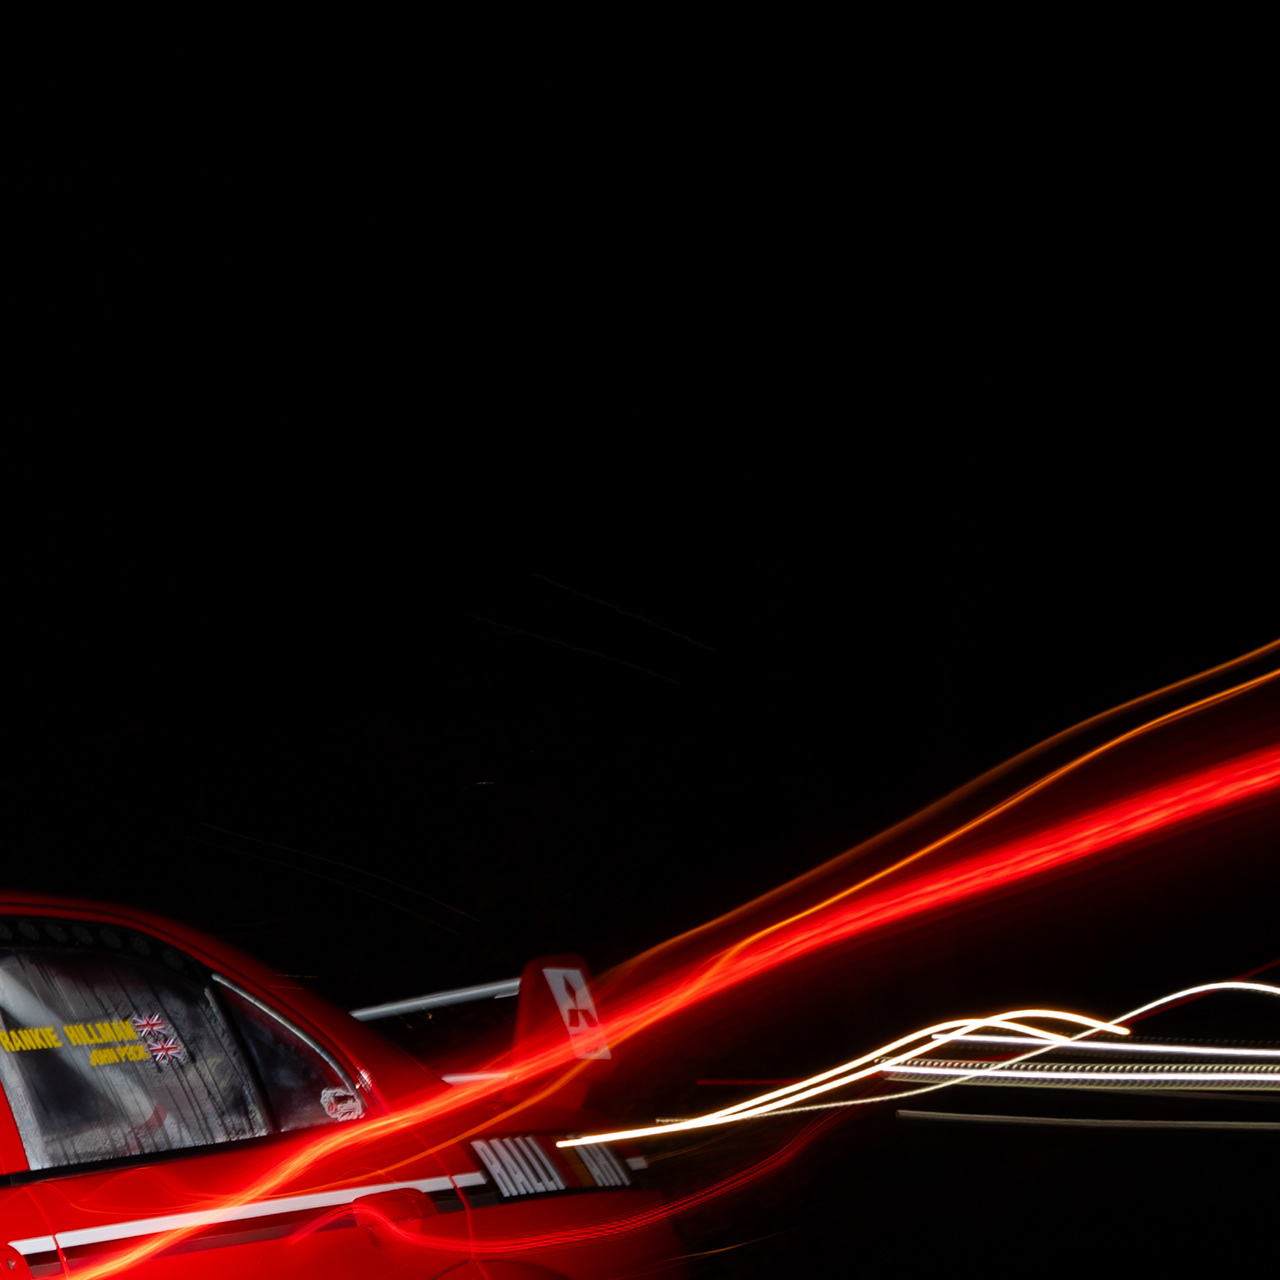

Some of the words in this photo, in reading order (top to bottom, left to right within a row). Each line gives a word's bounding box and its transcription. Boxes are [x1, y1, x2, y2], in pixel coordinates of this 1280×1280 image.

[63, 1019, 138, 1046] HILLMAN
[90, 1048, 120, 1066] JOHN
[471, 1136, 566, 1197] RALLI
